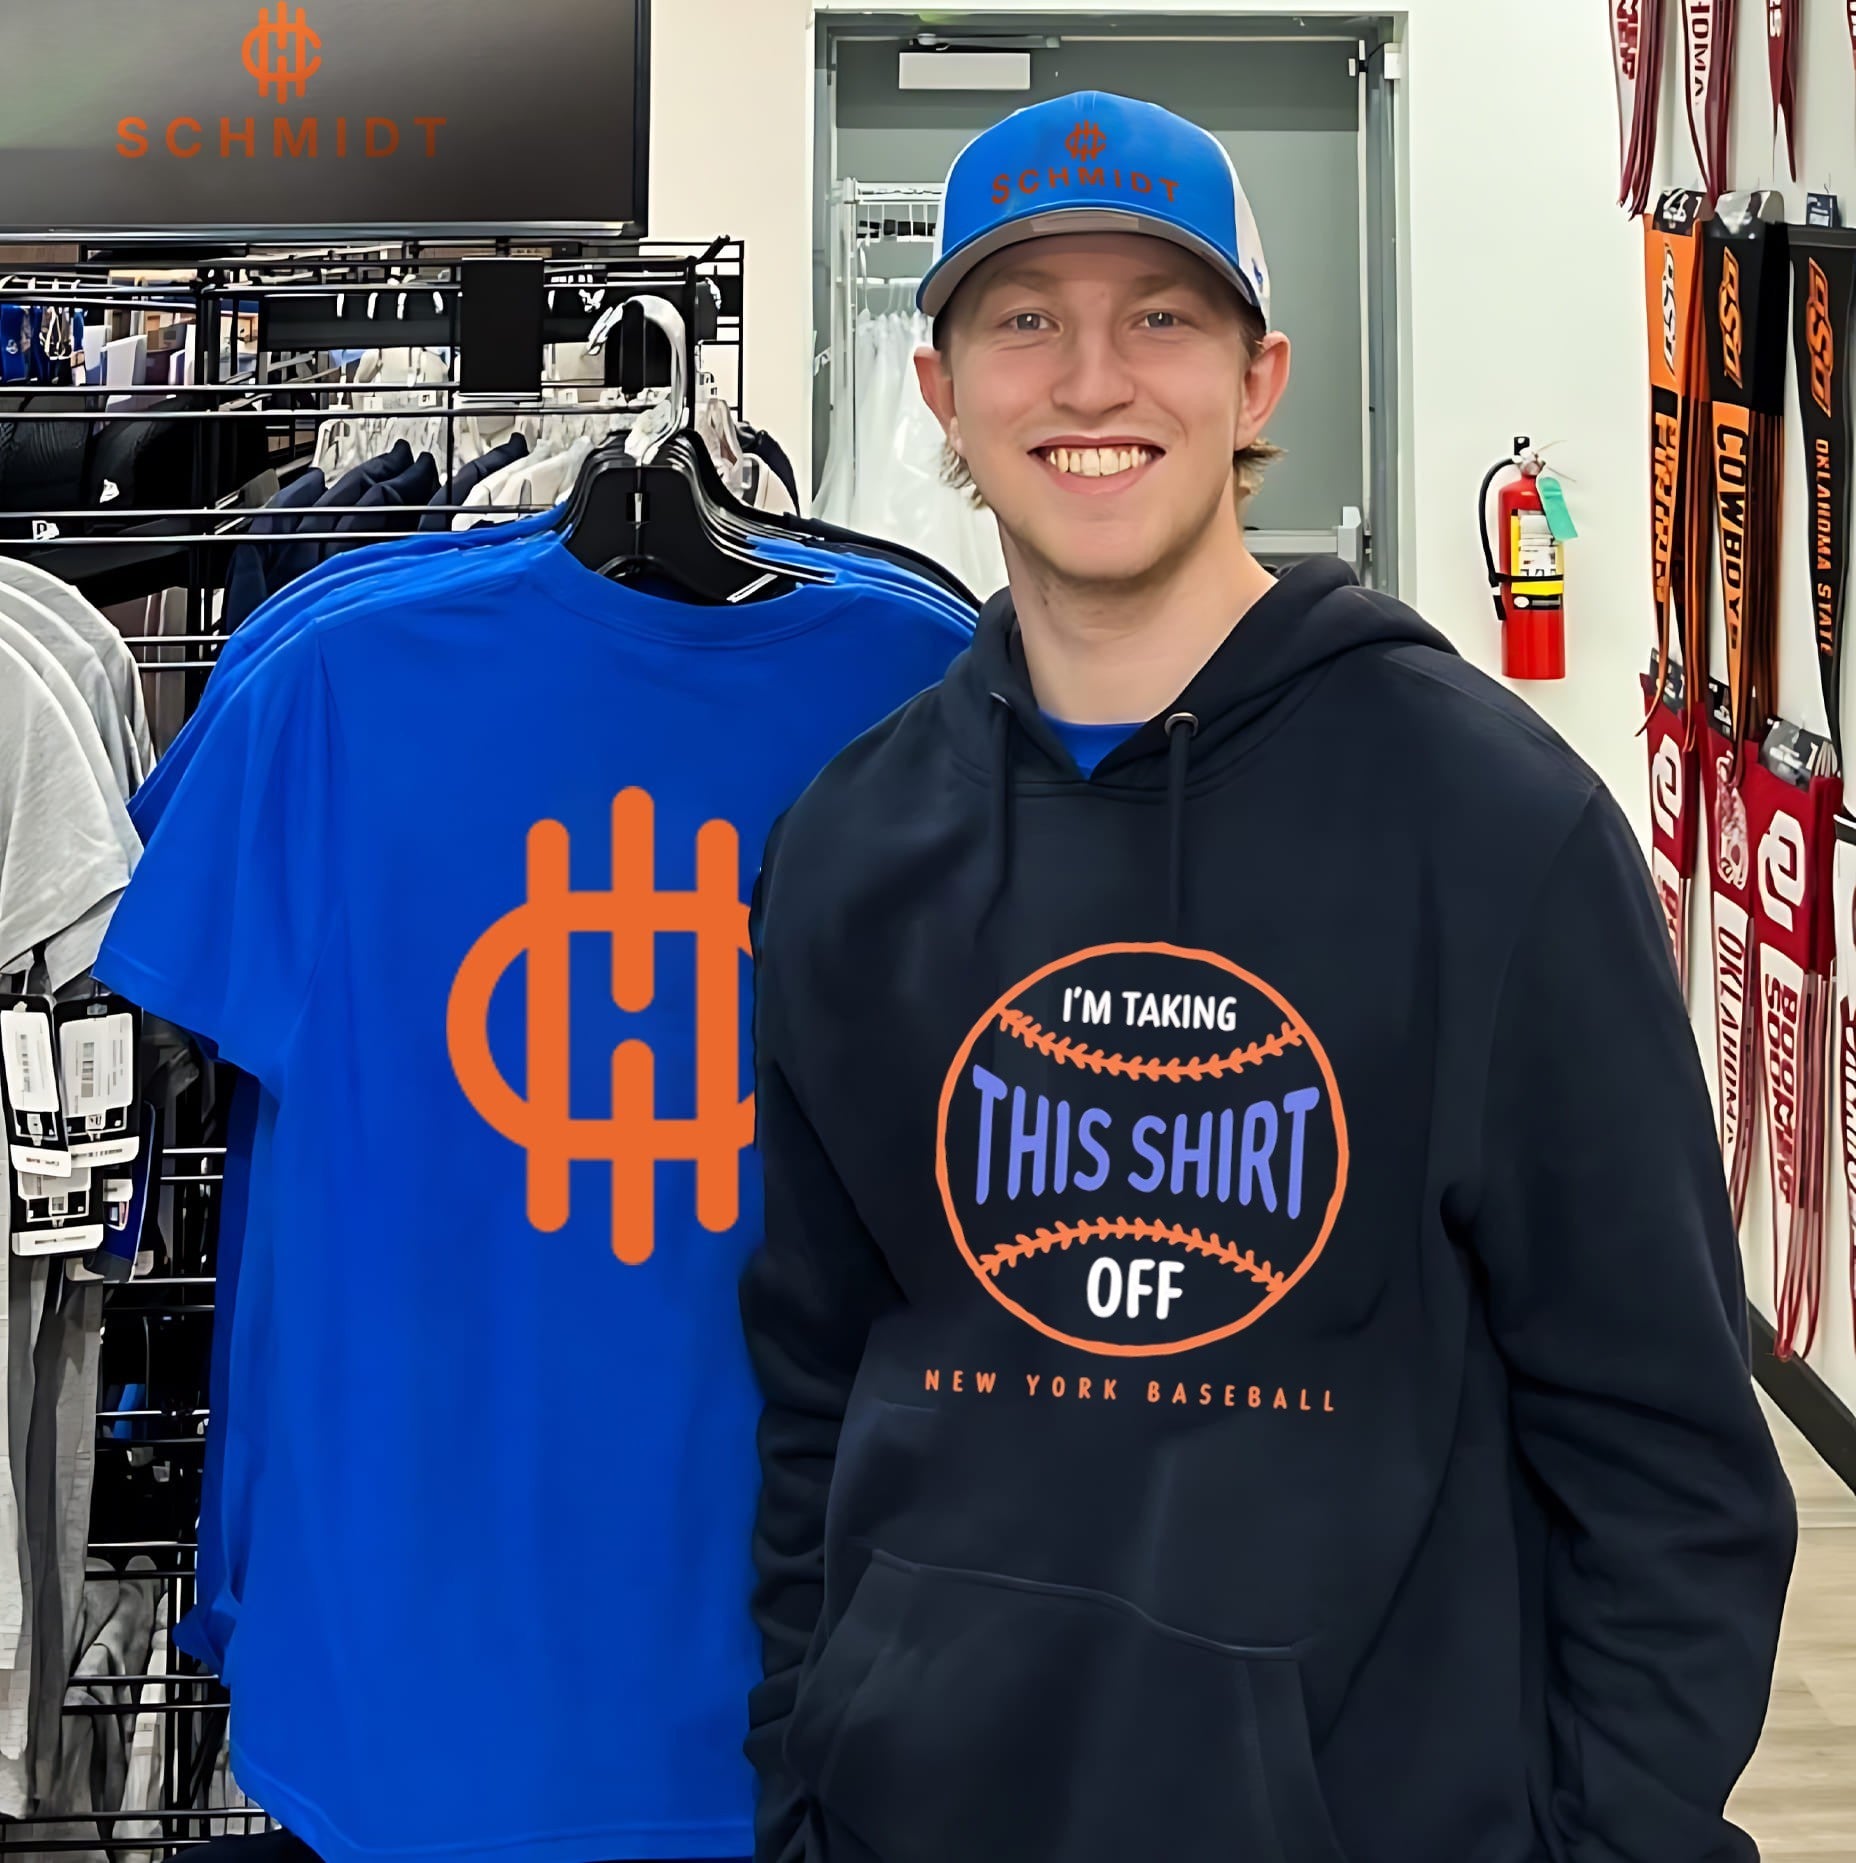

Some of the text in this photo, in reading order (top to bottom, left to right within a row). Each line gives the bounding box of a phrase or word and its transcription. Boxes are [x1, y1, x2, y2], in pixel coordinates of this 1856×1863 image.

[116, 117, 447, 158] SCHMIDT
[991, 167, 1179, 204] SCHMIDT
[1815, 438, 1832, 571] OKLAHOMA
[1062, 986, 1238, 1031] I'M TAKING
[1717, 926, 1745, 1143] OKLAHOMA
[972, 1064, 1320, 1219] THIS SHIRT
[1086, 1257, 1185, 1319] OFF
[925, 1369, 1335, 1412] NEW YORK BASEBALL
